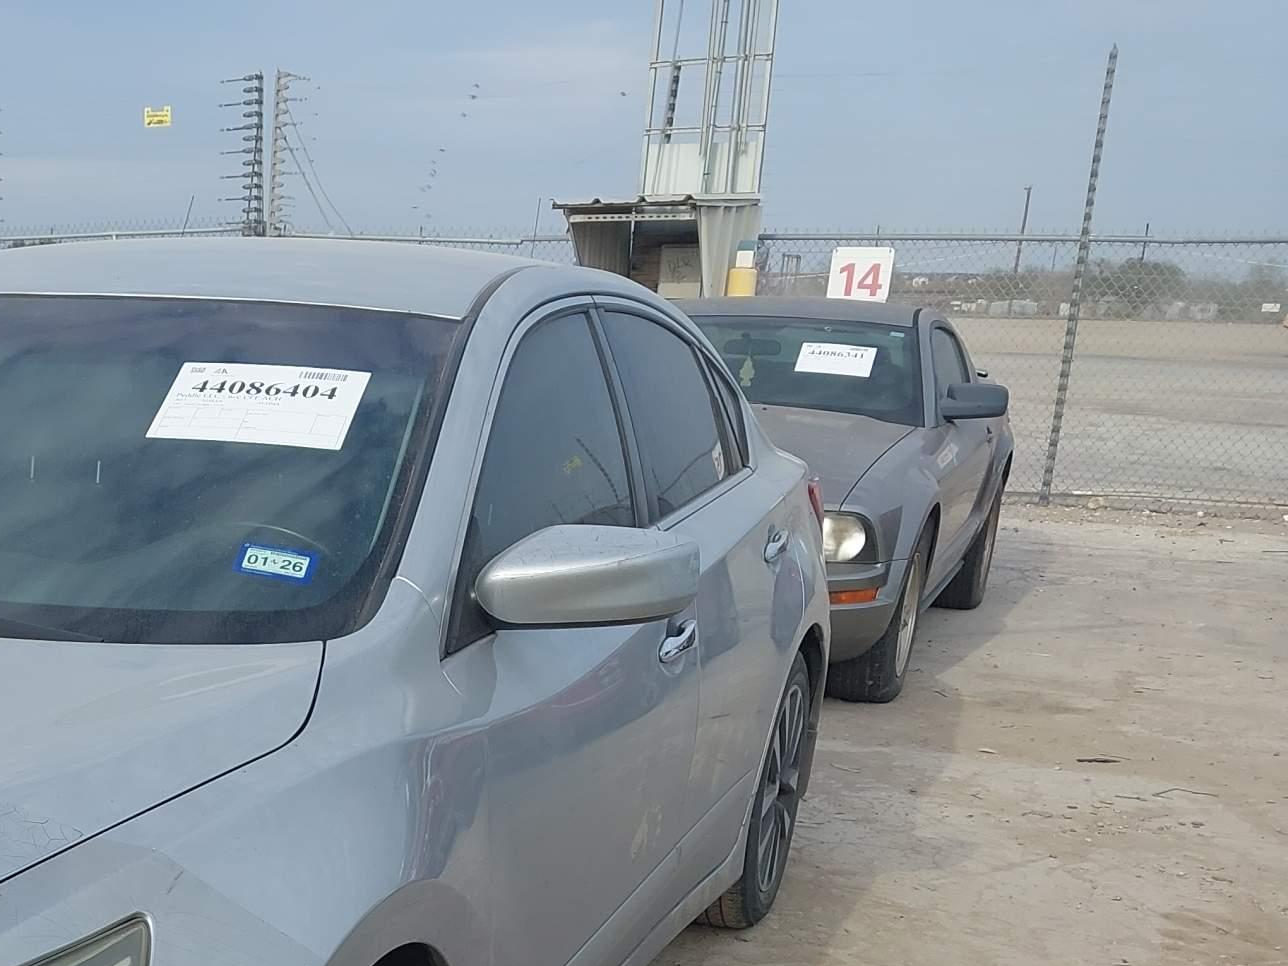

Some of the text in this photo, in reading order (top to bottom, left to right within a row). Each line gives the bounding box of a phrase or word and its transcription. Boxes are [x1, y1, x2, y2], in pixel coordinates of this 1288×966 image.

[839, 262, 883, 297] 14
[191, 379, 340, 400] 44086404
[247, 553, 269, 567] 01
[279, 559, 305, 573] 26
